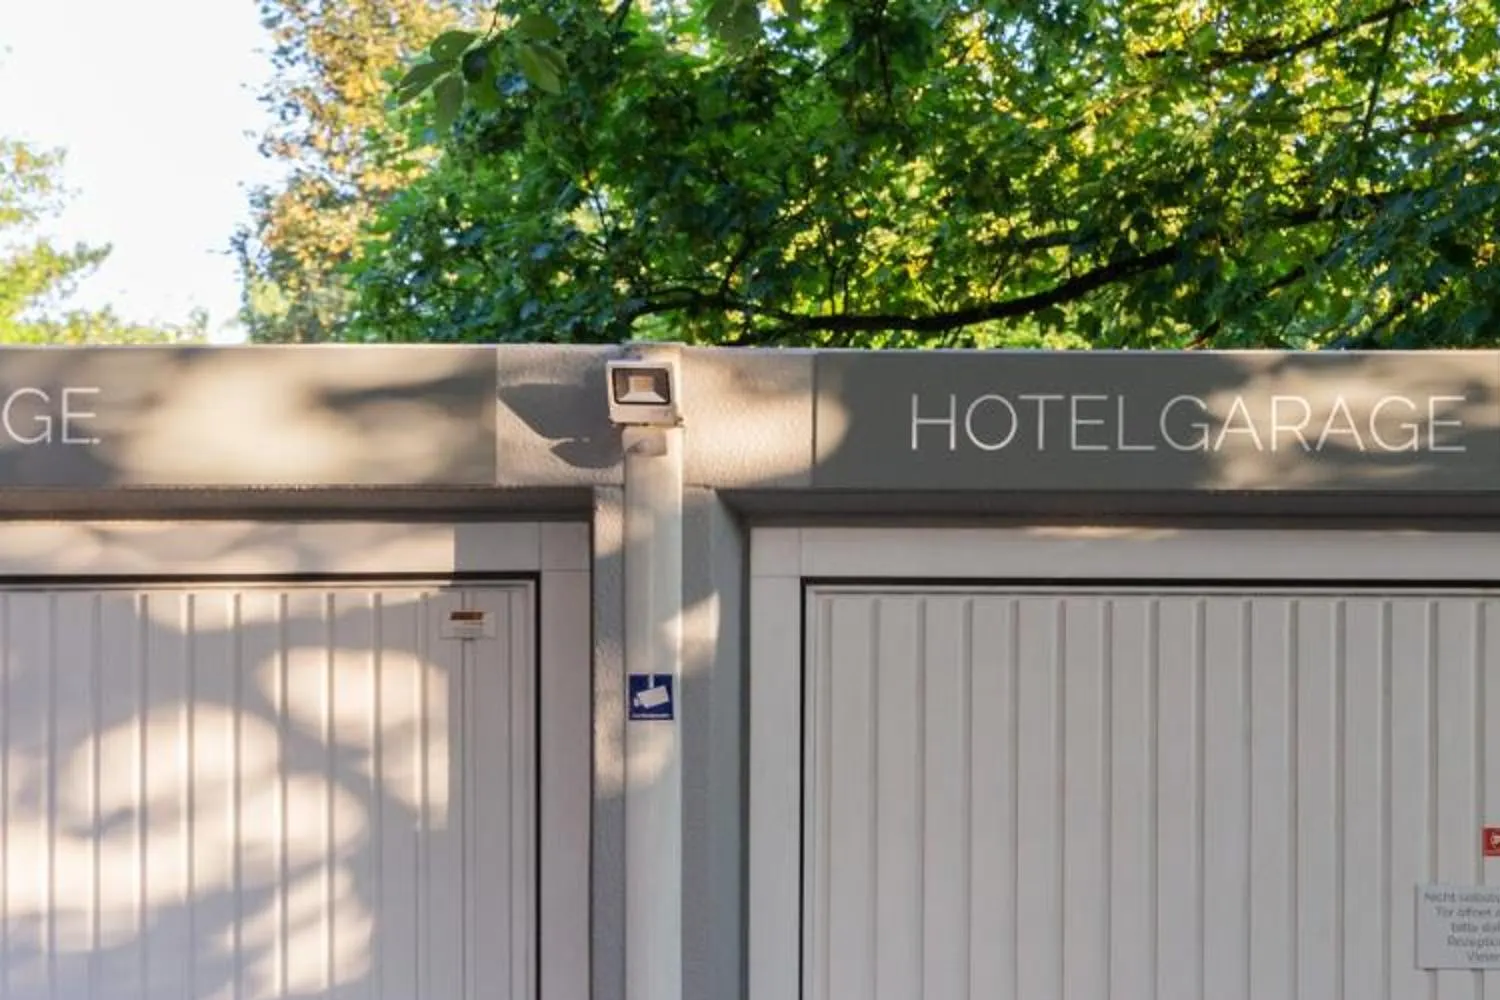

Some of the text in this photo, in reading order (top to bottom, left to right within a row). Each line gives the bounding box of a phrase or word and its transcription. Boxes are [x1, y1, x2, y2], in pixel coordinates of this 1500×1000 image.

[911, 393, 1467, 452] HOTELGARAGE
[1424, 891, 1455, 903] Nicht
[1435, 906, 1454, 917] Tor
